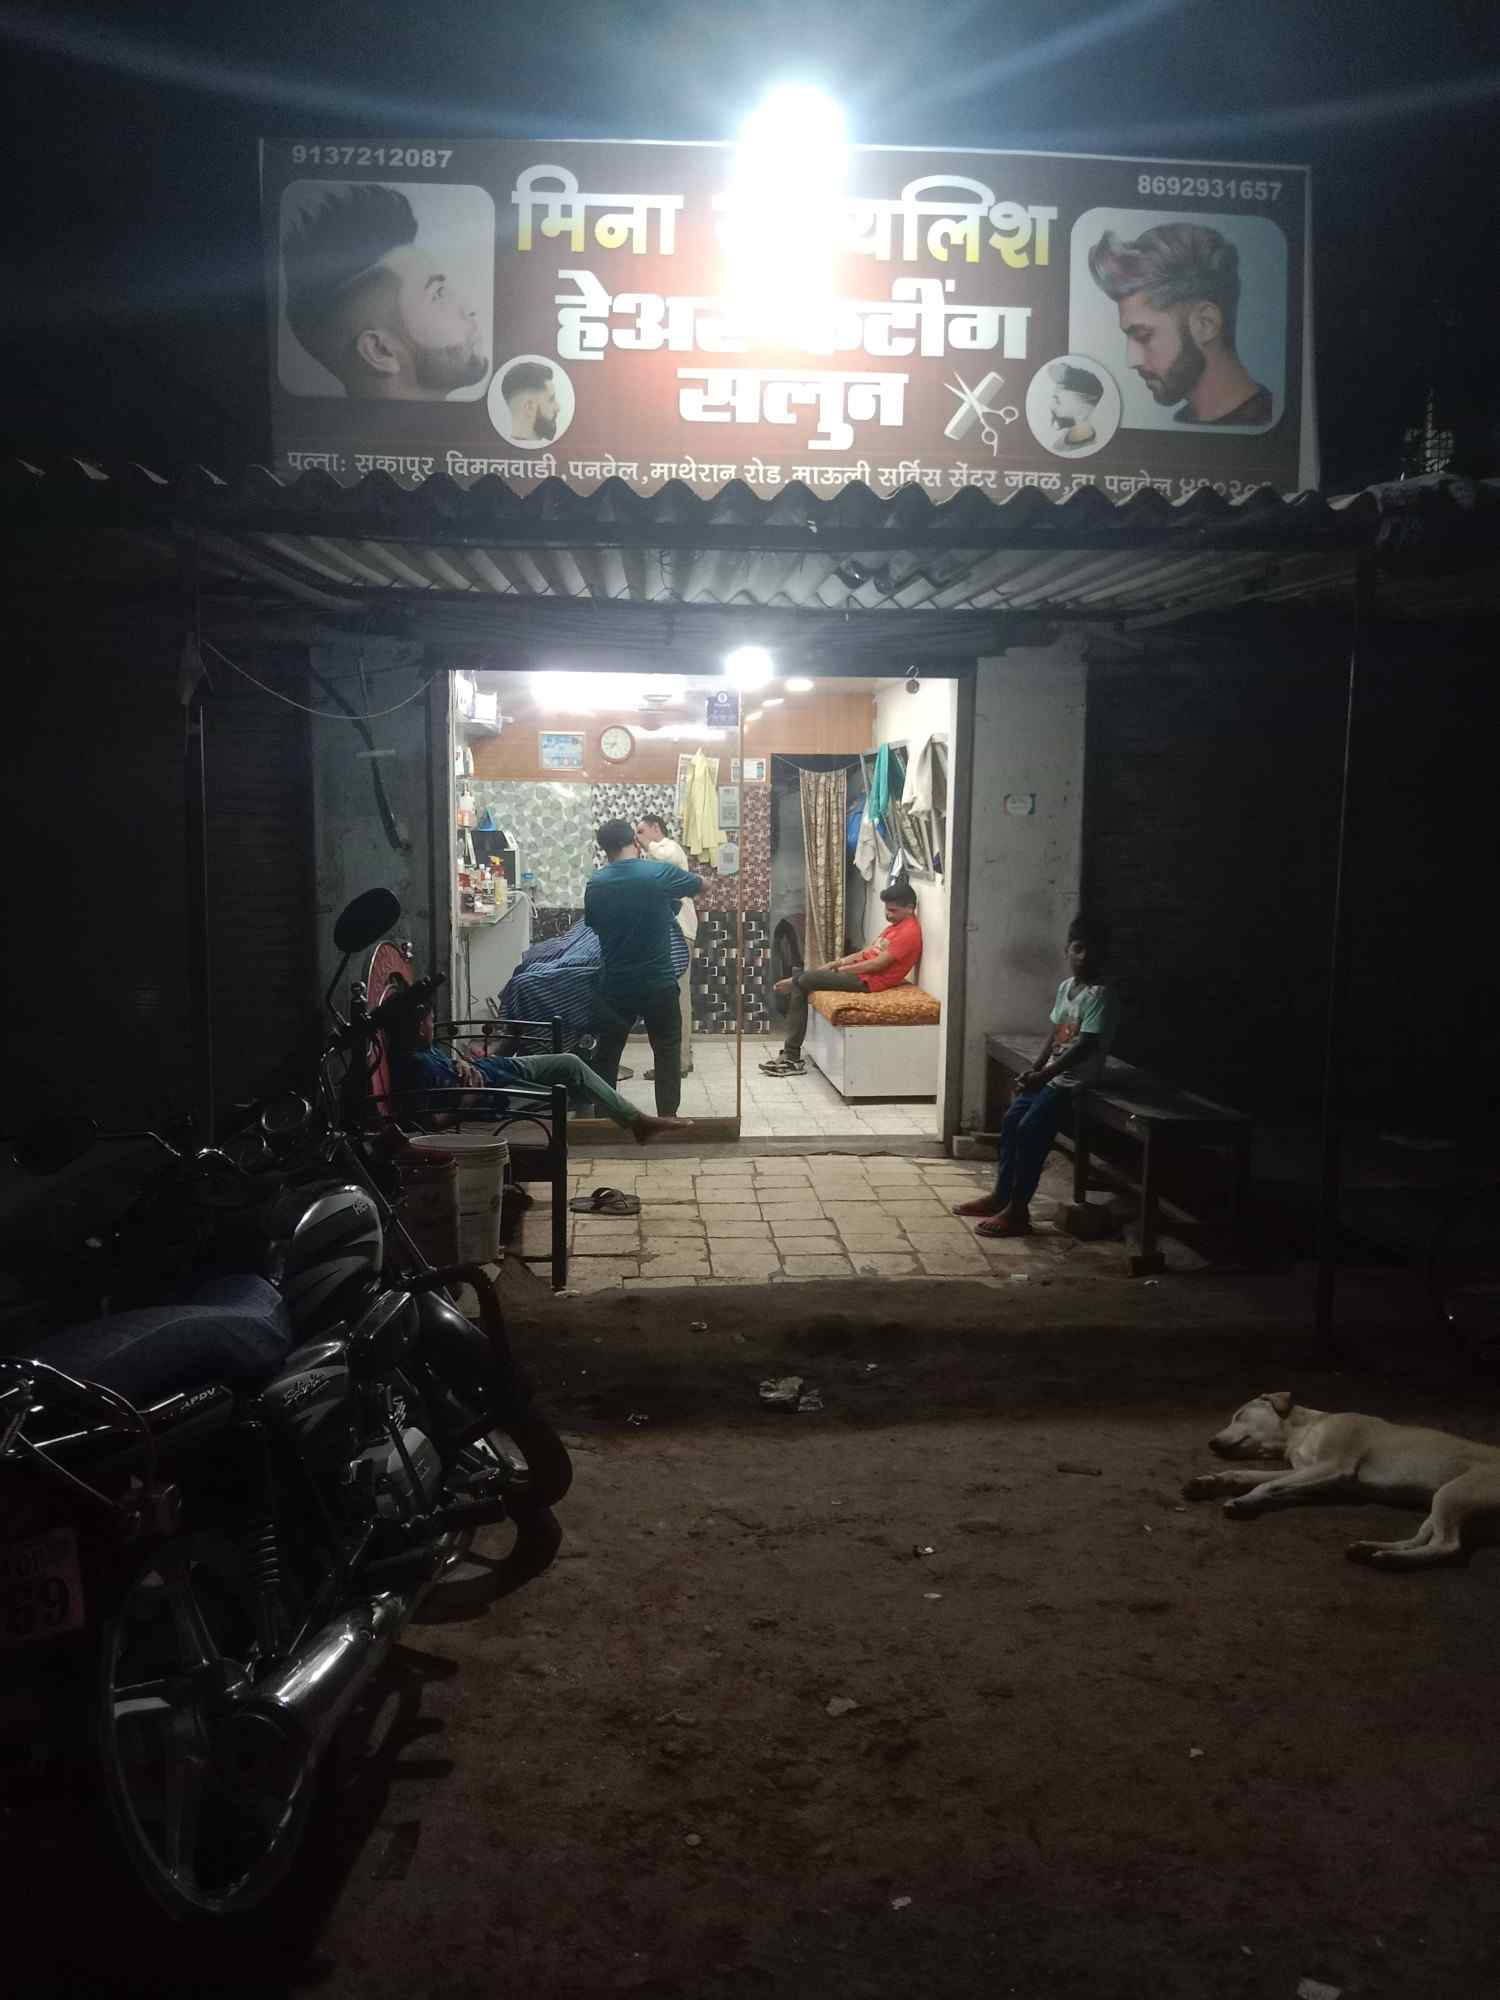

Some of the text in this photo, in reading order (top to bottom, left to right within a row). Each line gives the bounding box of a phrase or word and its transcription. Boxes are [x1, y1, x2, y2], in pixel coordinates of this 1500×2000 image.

[291, 145, 453, 168] 9137212087
[1137, 174, 1283, 200] 8692931657
[511, 164, 684, 255] मिना
